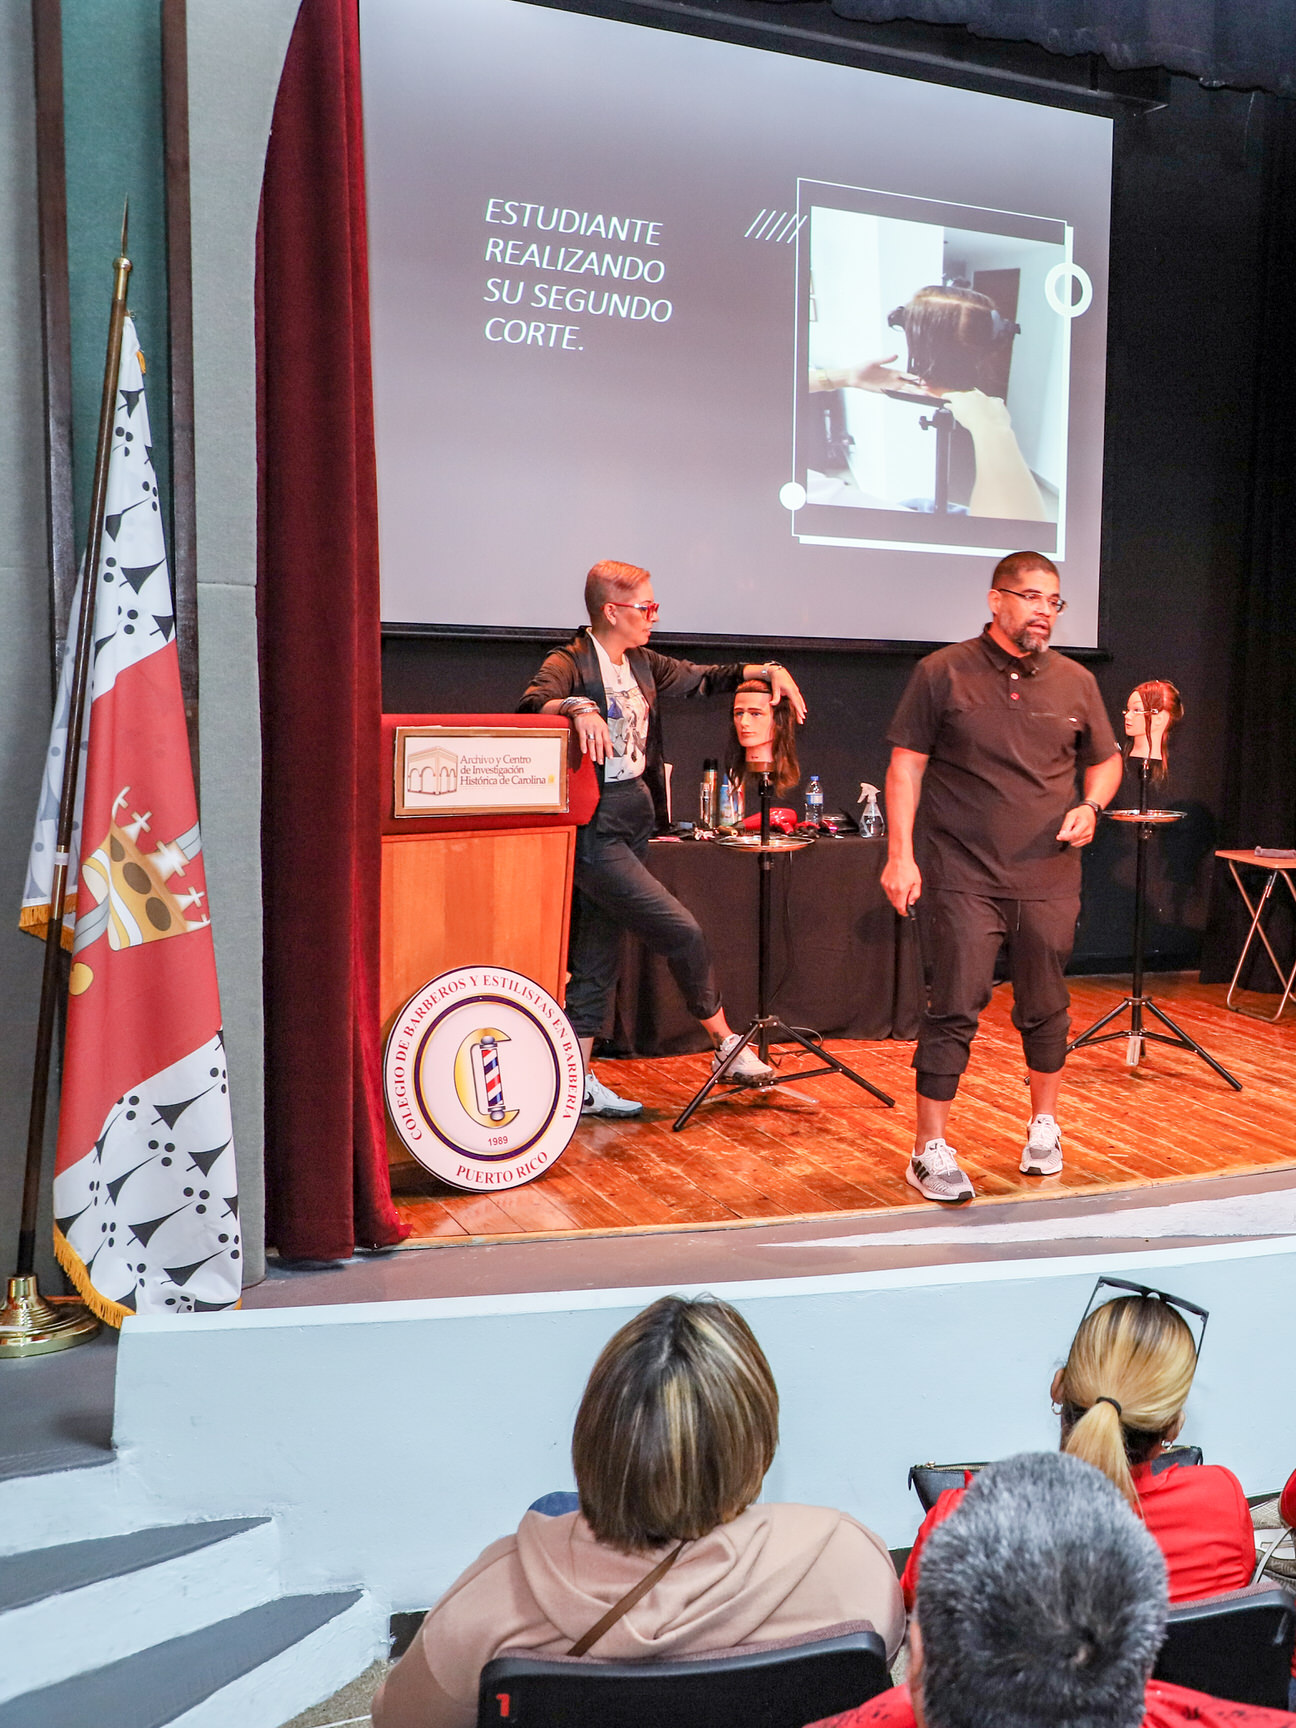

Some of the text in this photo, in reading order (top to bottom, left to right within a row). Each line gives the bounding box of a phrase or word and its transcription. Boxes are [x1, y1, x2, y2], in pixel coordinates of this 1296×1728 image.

[485, 198, 663, 246] ESTUDIANTE
[484, 237, 665, 283] REALIZANDO
[483, 278, 673, 323] SU SEGUNDO
[484, 317, 584, 351] CORTE.
[460, 754, 532, 765] Archivo y Centro
[460, 765, 524, 777] de Investigación
[460, 775, 546, 785] Histórica de Carolina
[469, 976, 479, 987] Y
[404, 978, 467, 1037] BARBEROS
[483, 975, 555, 1019] ESTILISTAS
[552, 1019, 568, 1039] EN
[396, 1039, 410, 1062] DE
[394, 1067, 423, 1141] COLEGIO
[488, 1136, 509, 1146] 1989
[456, 1151, 548, 1184] PUERTO RICO
[496, 1693, 510, 1717] 1
